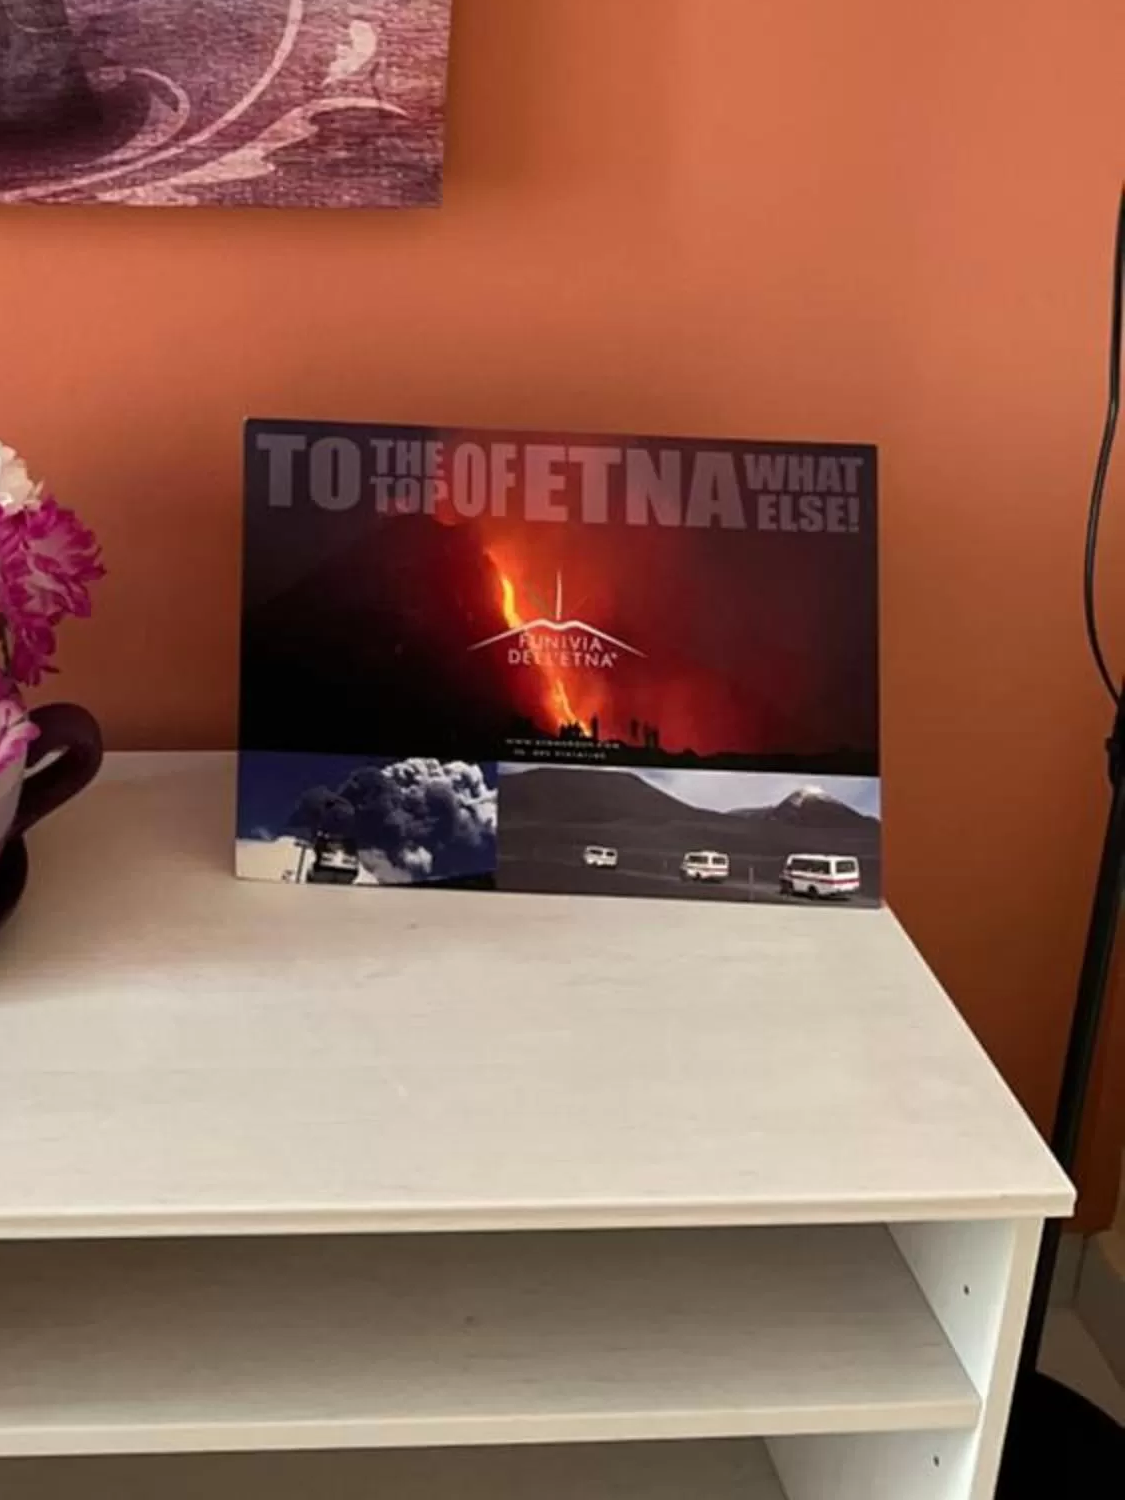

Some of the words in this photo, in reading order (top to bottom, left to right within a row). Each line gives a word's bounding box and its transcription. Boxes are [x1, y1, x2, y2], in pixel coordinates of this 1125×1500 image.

[256, 433, 361, 511] TO
[370, 439, 444, 477] THE
[743, 454, 864, 492] WHAT
[370, 476, 450, 515] TOP
[452, 442, 517, 517] OF
[523, 443, 748, 530] ETNA
[757, 495, 860, 532] ELSE!
[519, 632, 603, 652] FUNIVIA
